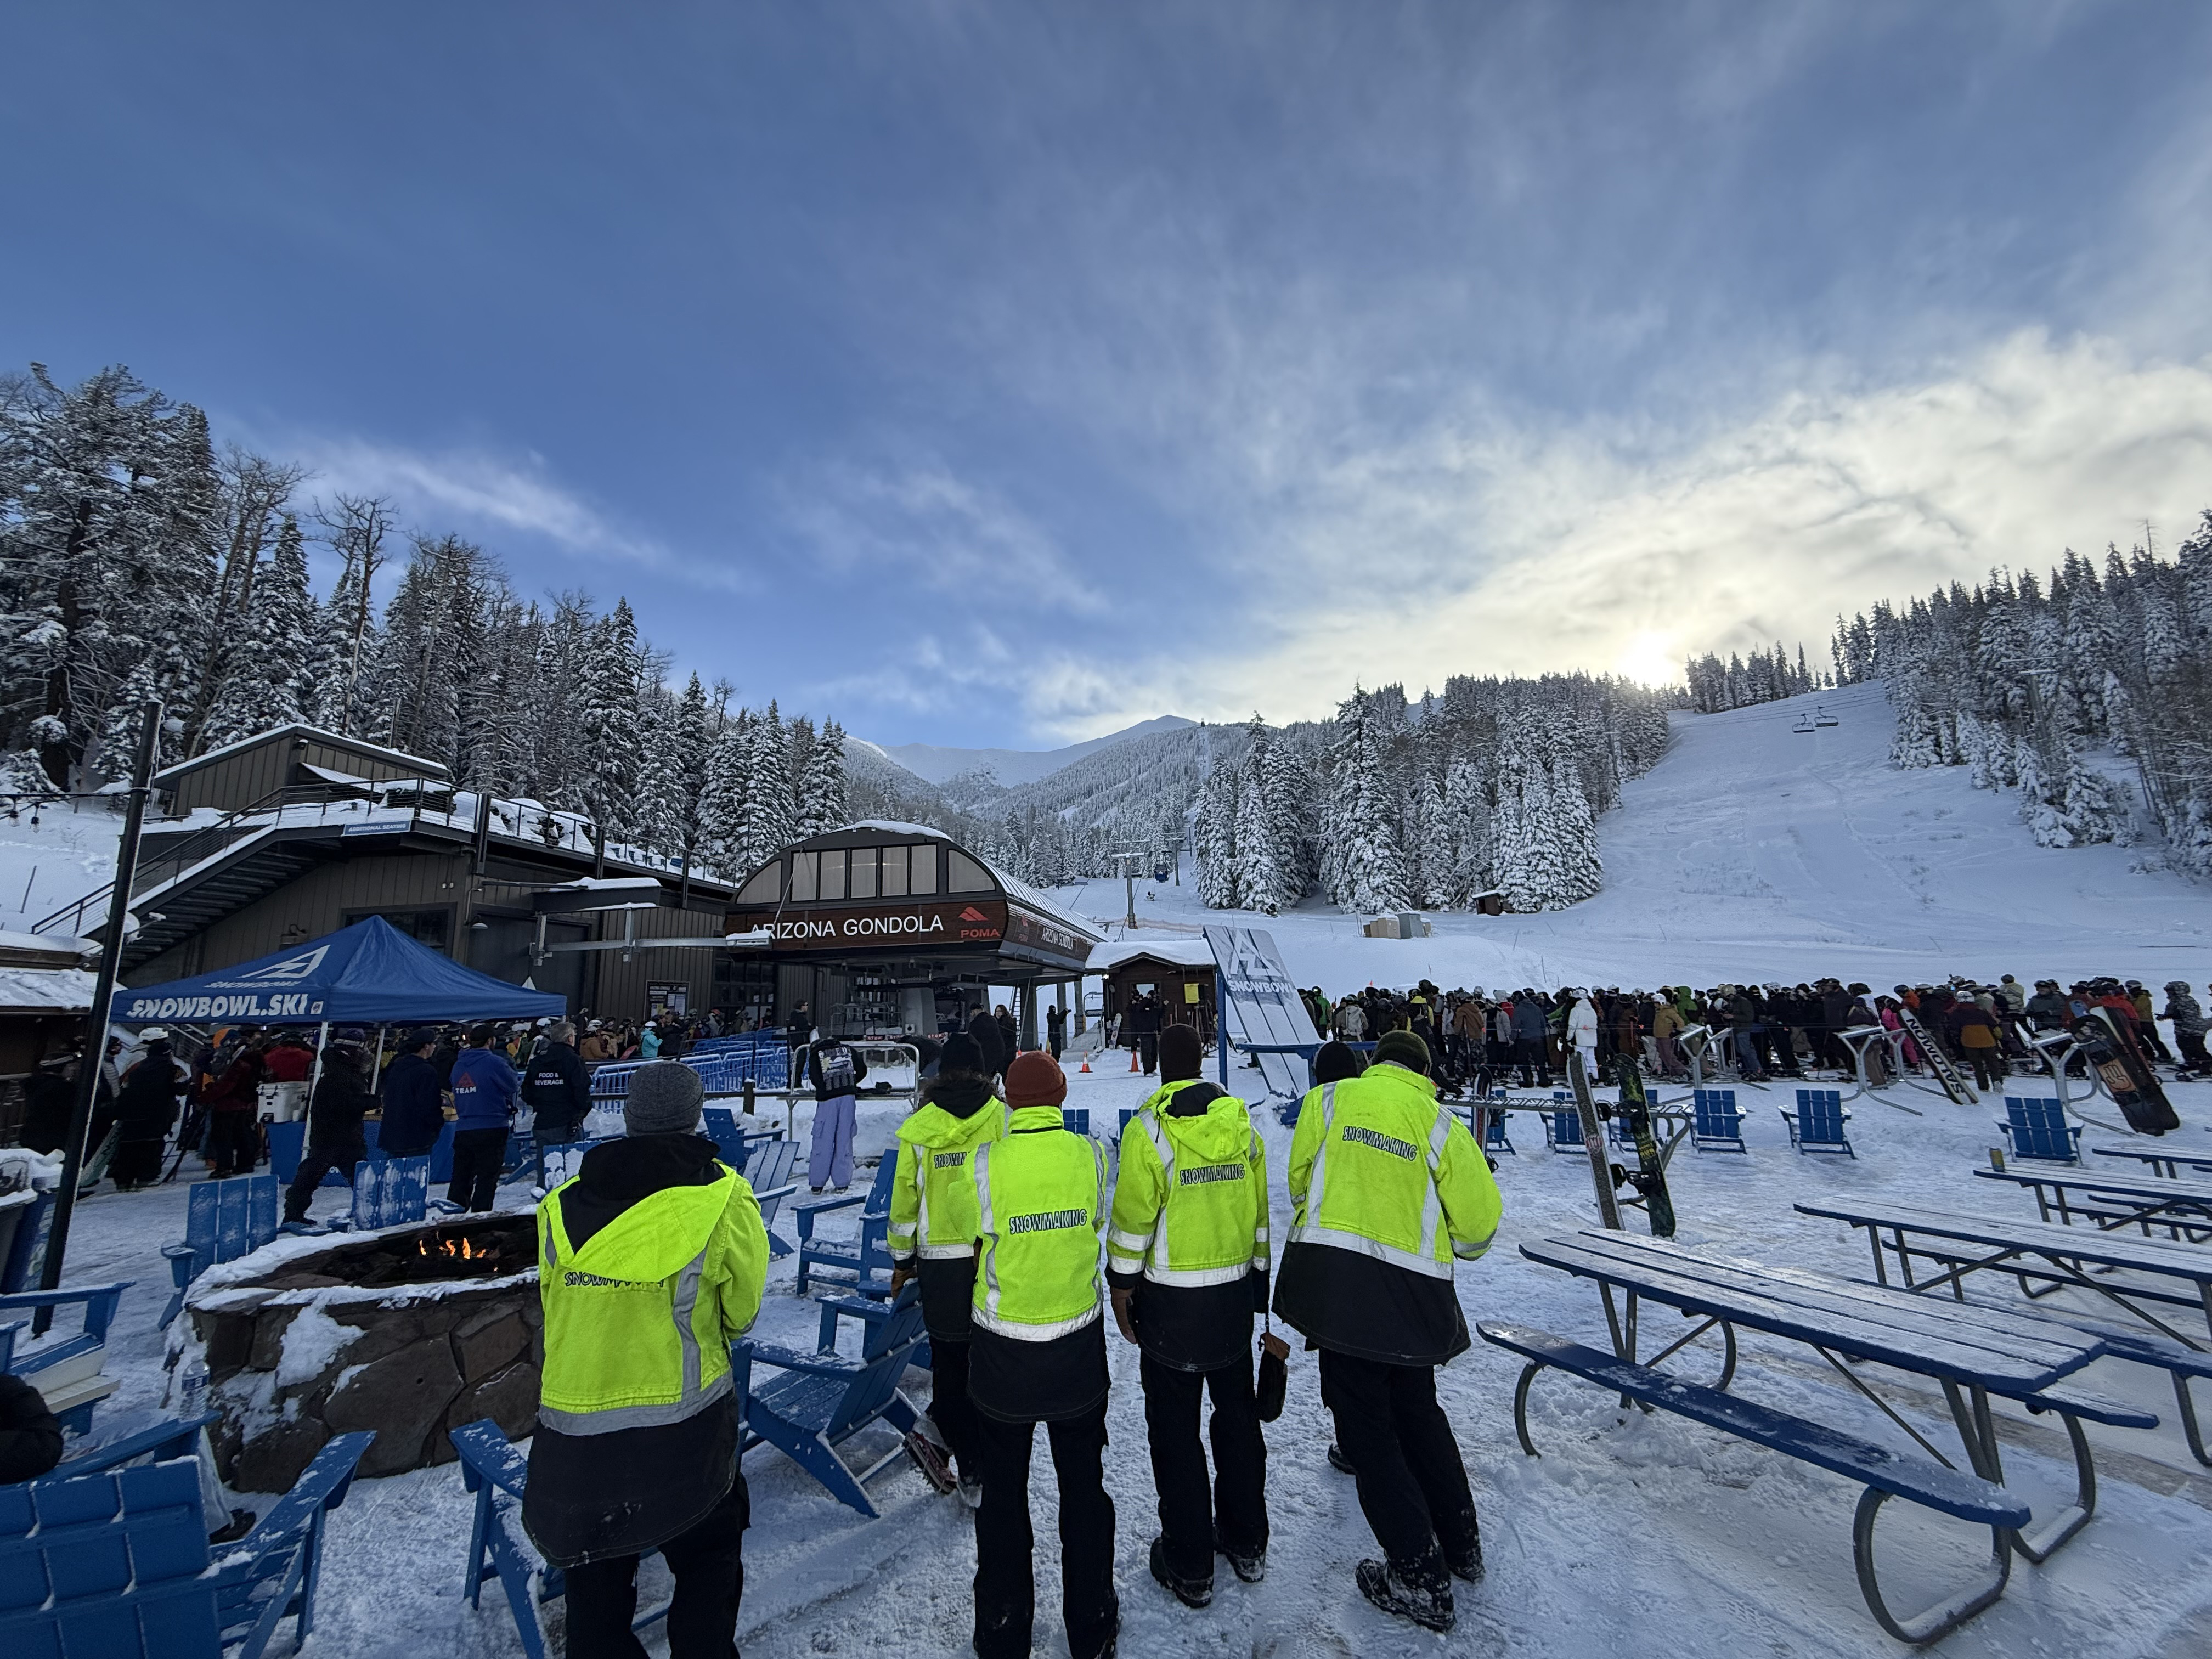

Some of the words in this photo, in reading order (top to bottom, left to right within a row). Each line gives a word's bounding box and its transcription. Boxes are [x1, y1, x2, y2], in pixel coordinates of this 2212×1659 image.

[843, 915, 944, 936] GONDOLA
[961, 928, 1001, 939] POMA
[1041, 927, 1058, 944] ARIZONA
[126, 994, 308, 1018] SNOWBOWL.SKI
[1906, 1018, 1965, 1093] SALOMON
[1342, 1125, 1417, 1161] SNOWMAKING
[1180, 1163, 1245, 1186] SNOWMAKING
[1009, 1209, 1087, 1235] SNOWMAKING
